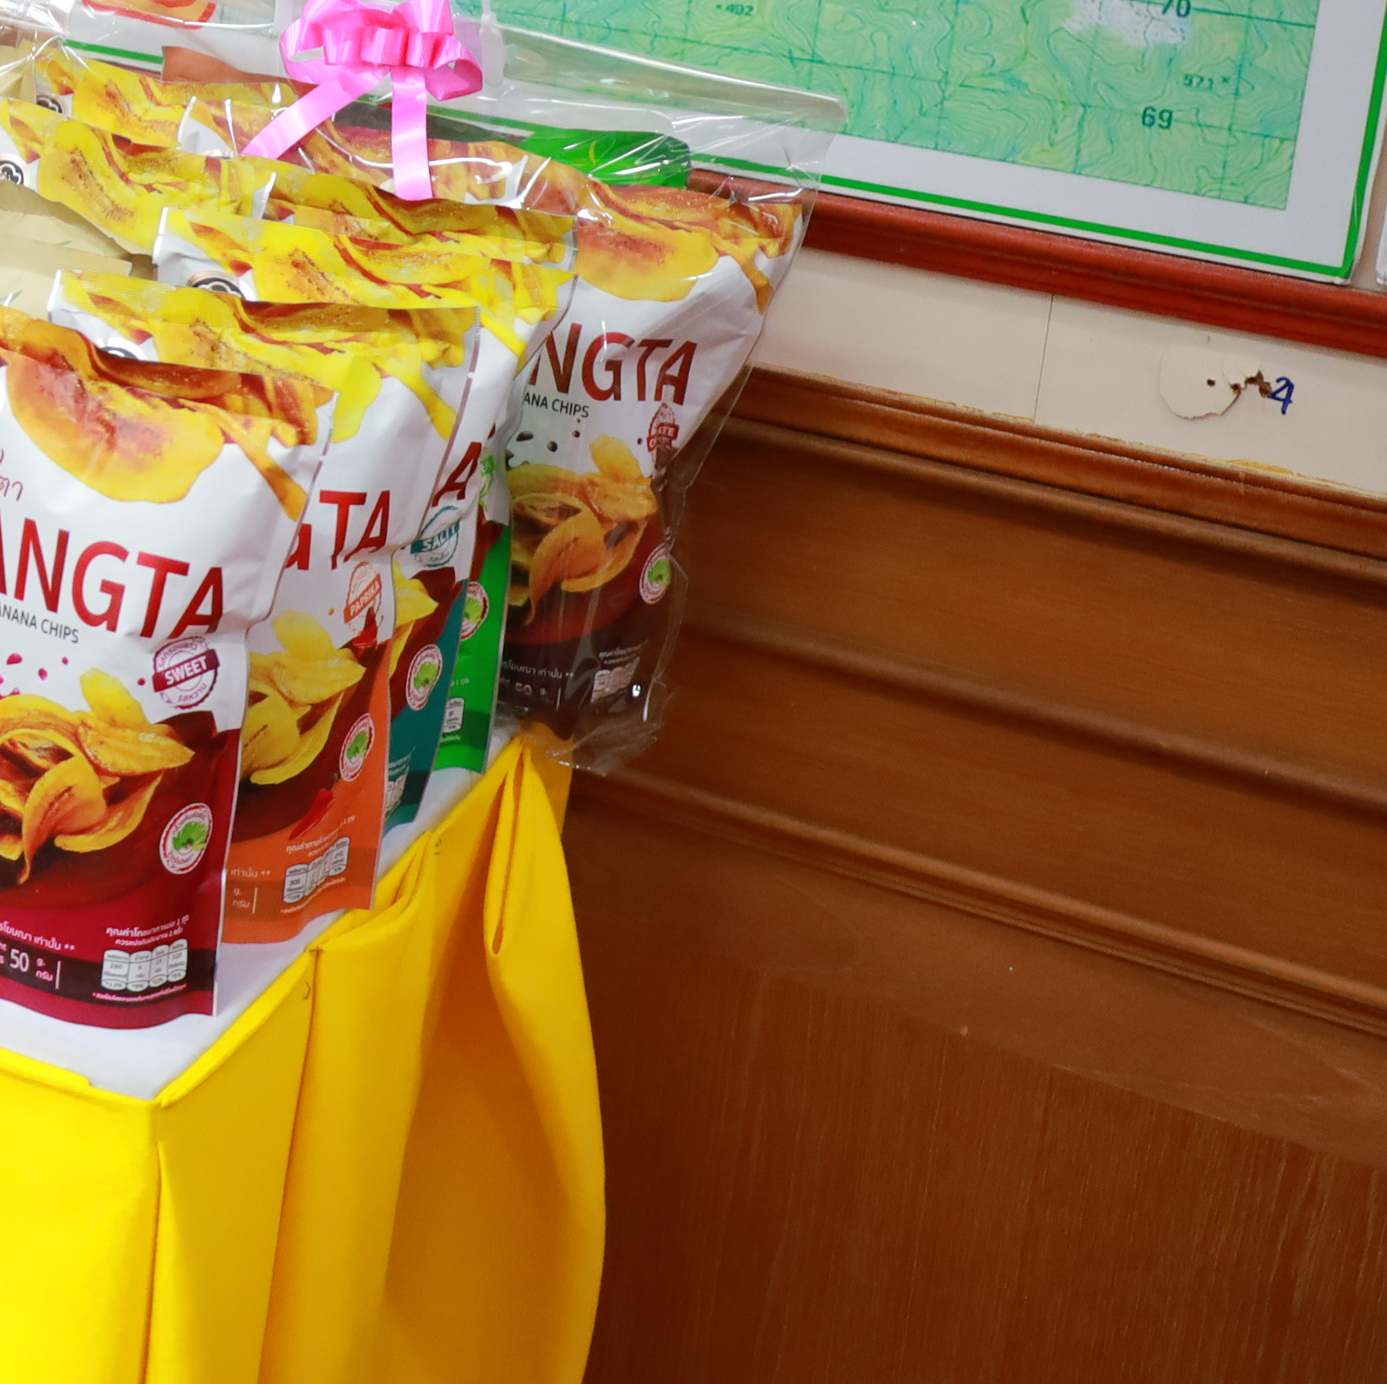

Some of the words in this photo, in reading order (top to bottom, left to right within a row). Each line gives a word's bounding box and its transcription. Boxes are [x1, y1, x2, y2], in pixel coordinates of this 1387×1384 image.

[1140, 105, 1174, 130] 69
[551, 398, 590, 419] CHIPS
[348, 578, 381, 618] PAPRIKA
[41, 619, 79, 645] CHIPS
[164, 657, 208, 688] SWEET
[10, 948, 30, 972] 50
